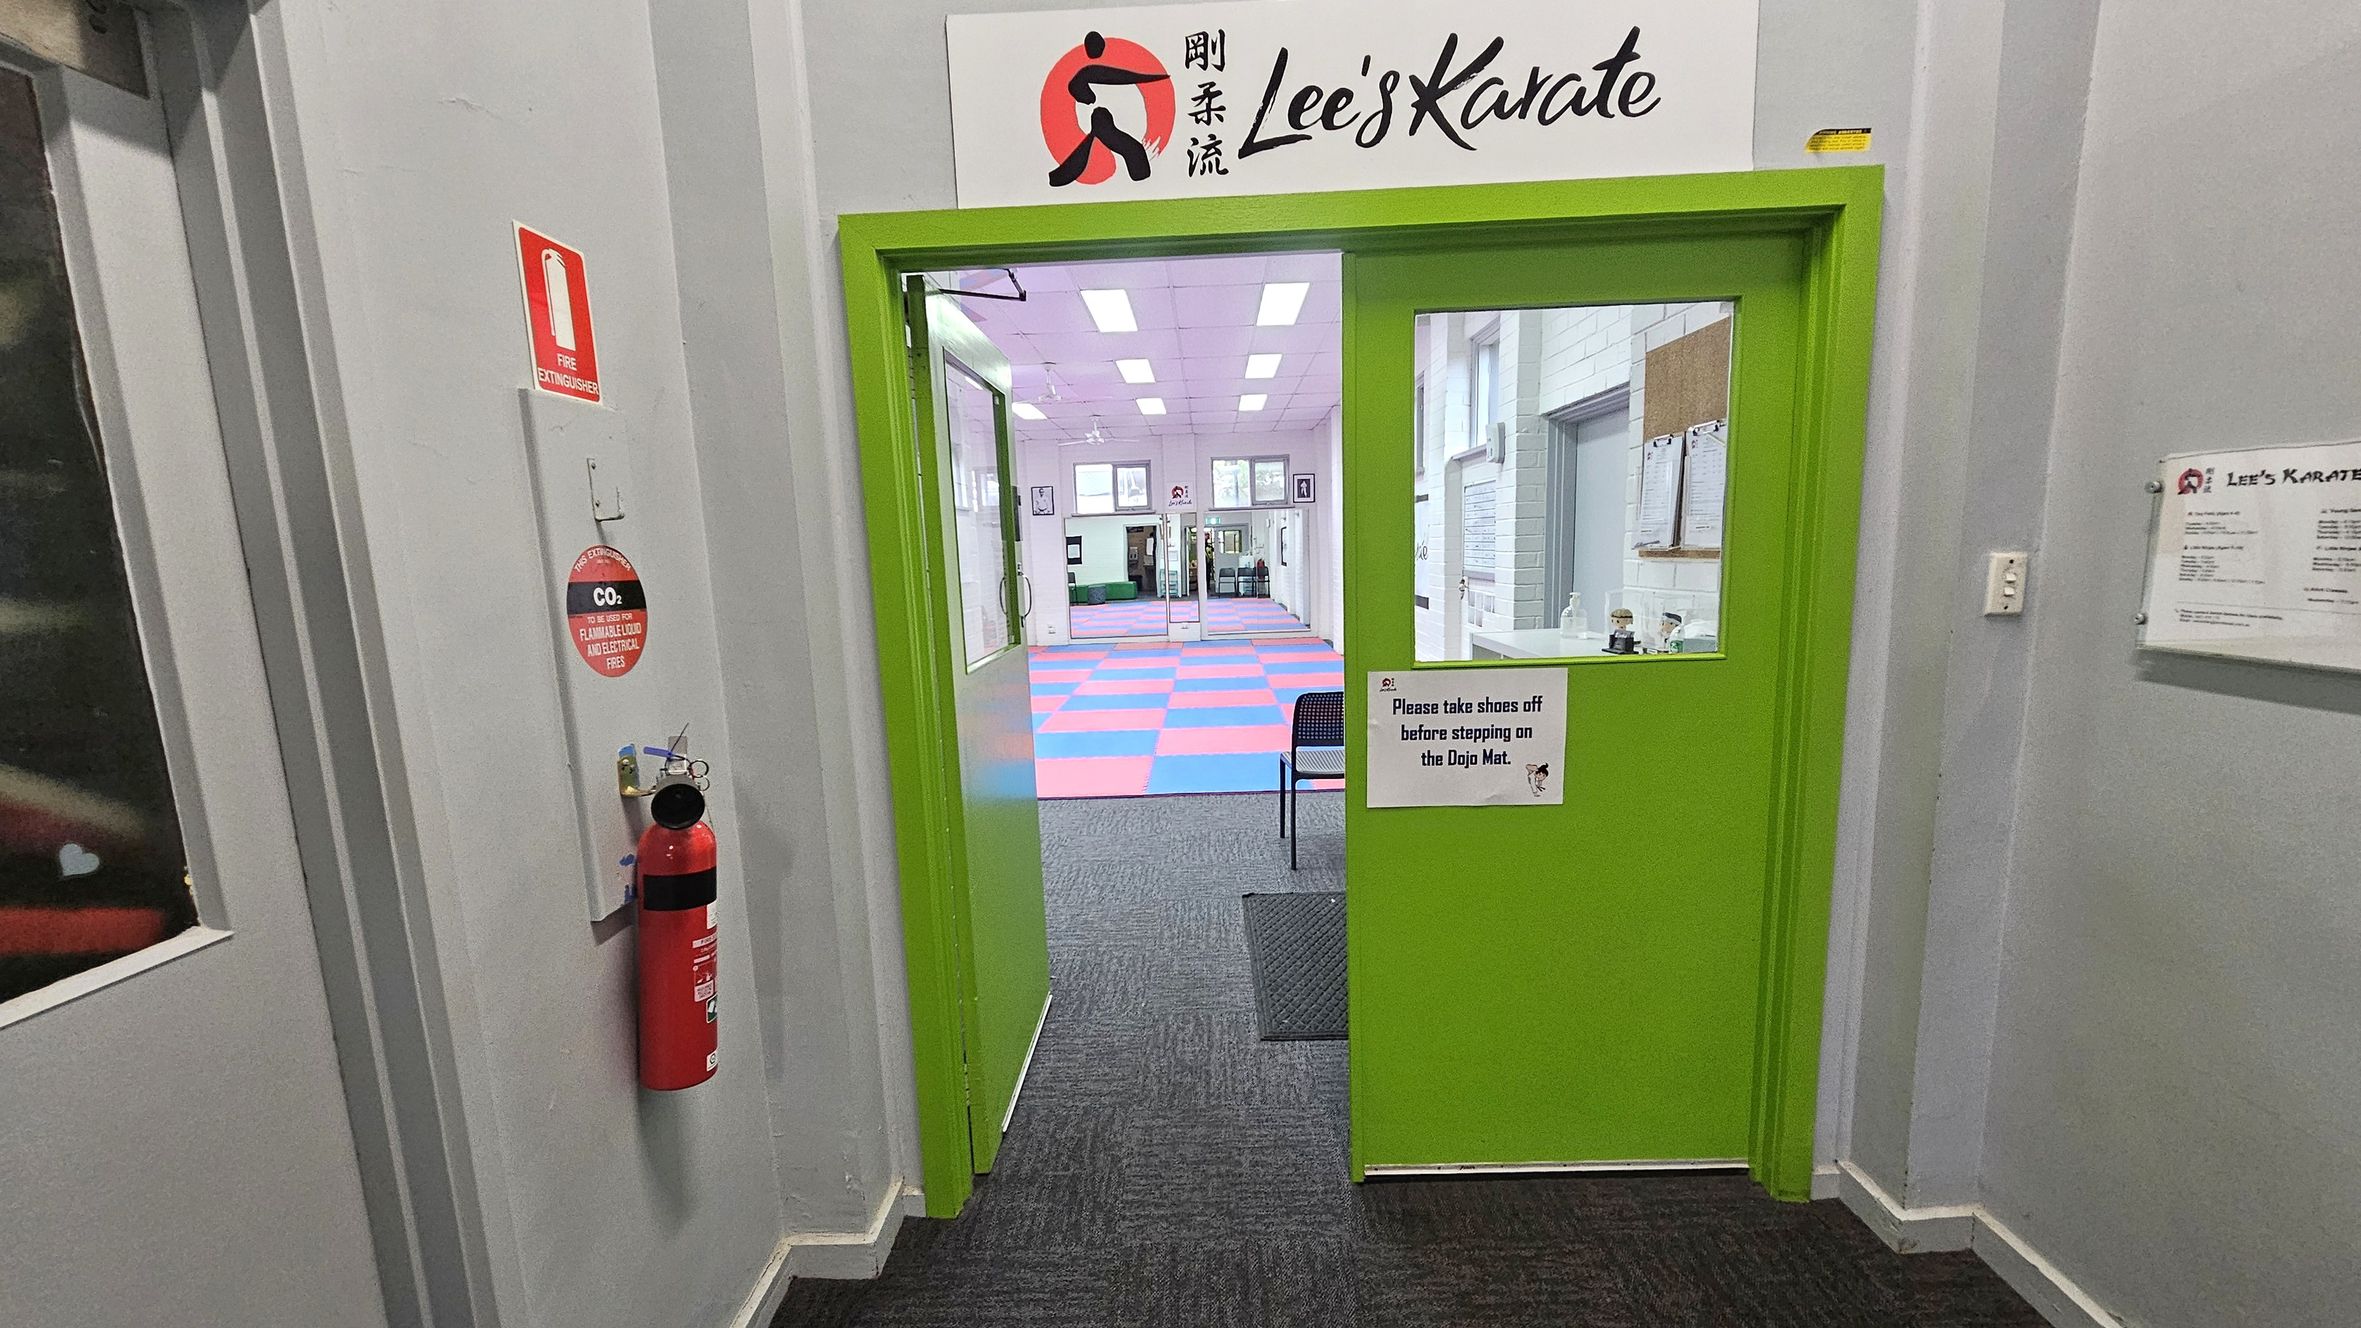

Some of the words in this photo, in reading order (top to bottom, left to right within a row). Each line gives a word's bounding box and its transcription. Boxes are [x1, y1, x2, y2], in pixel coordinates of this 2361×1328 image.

[1238, 47, 1400, 159] Lee's
[1409, 25, 1661, 151] Karate
[1184, 29, 1229, 177] 剛柔流
[557, 353, 577, 371] FIRE
[538, 368, 599, 395] EXTINGUISHER
[574, 555, 587, 572] THIS
[587, 616, 595, 624] TO
[607, 614, 620, 623] USED
[621, 613, 633, 622] FOR
[580, 624, 622, 641] FLAMMABLE
[622, 622, 642, 635] LIQUID
[587, 643, 602, 657] AND
[602, 641, 640, 656] ELECTRICAL
[607, 656, 625, 670] FIRES
[1392, 698, 1439, 715] Please
[1443, 697, 1473, 714] take
[1478, 696, 1519, 713] shoes
[1523, 695, 1543, 713] off
[1401, 724, 1447, 741] before
[1452, 724, 1511, 743] stepping
[1516, 726, 1533, 739] on
[1421, 750, 1443, 766] the
[1447, 749, 1478, 769] Dojo
[1482, 748, 1511, 766] Mat.
